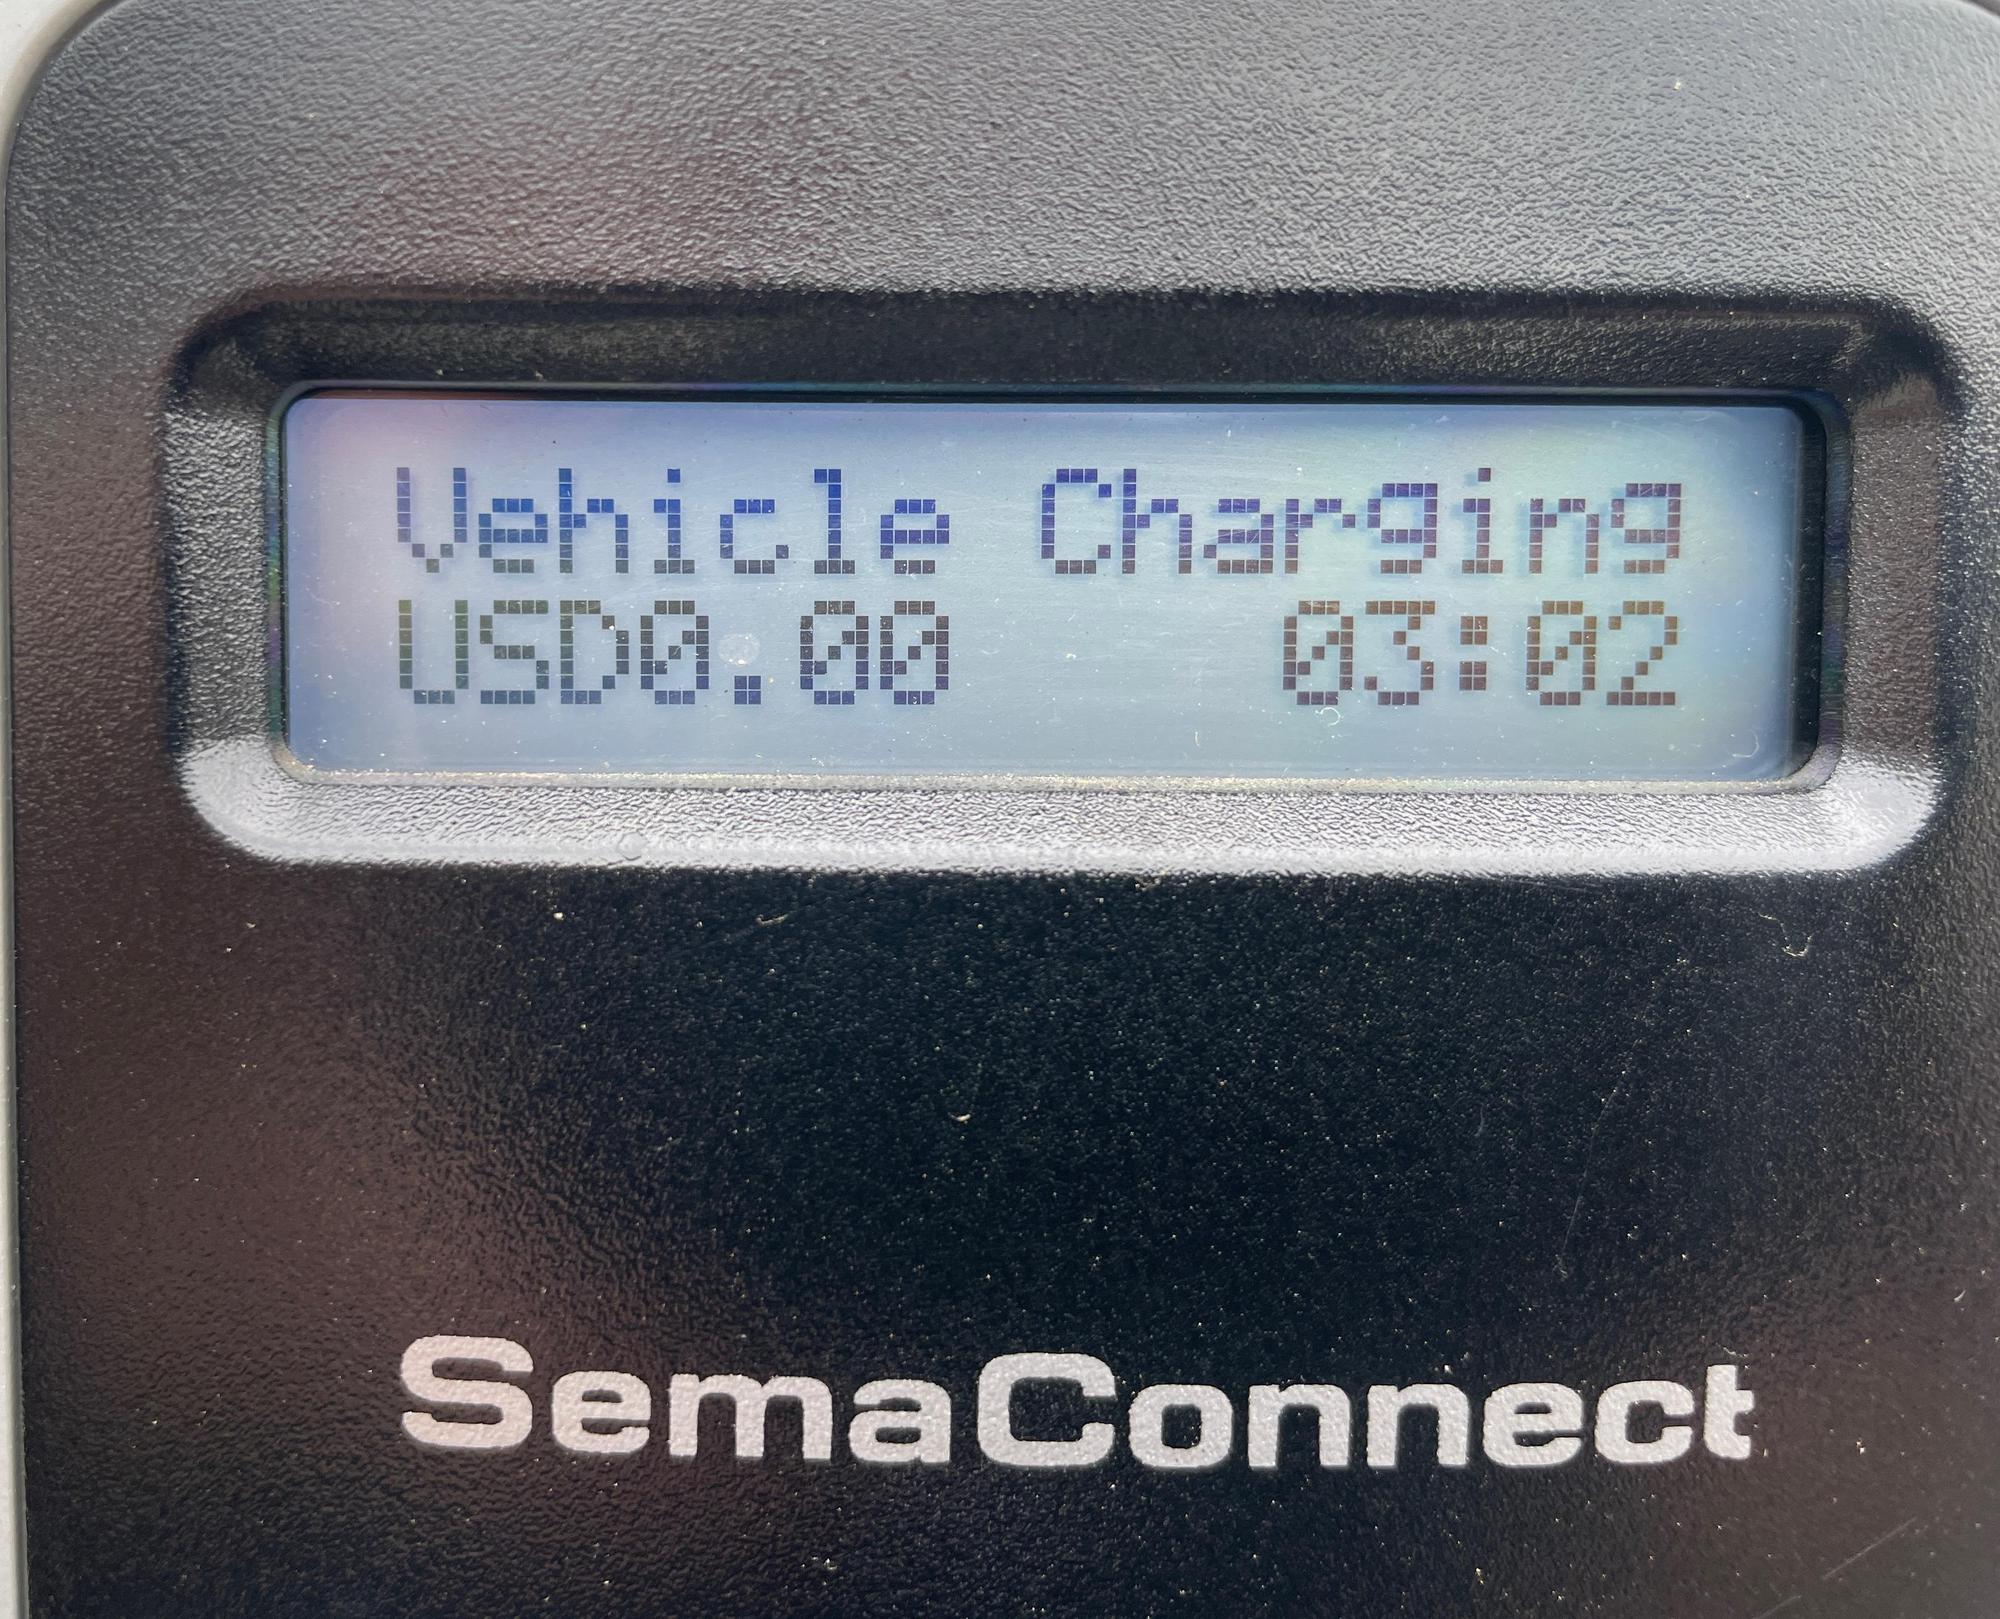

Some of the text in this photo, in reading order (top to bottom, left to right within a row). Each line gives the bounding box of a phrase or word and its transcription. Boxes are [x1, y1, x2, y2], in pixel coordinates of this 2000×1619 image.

[396, 467, 1682, 574] Vehicle Charging
[399, 599, 1678, 705] USD0.00 03:02
[400, 1334, 1757, 1470] SemaConnect
